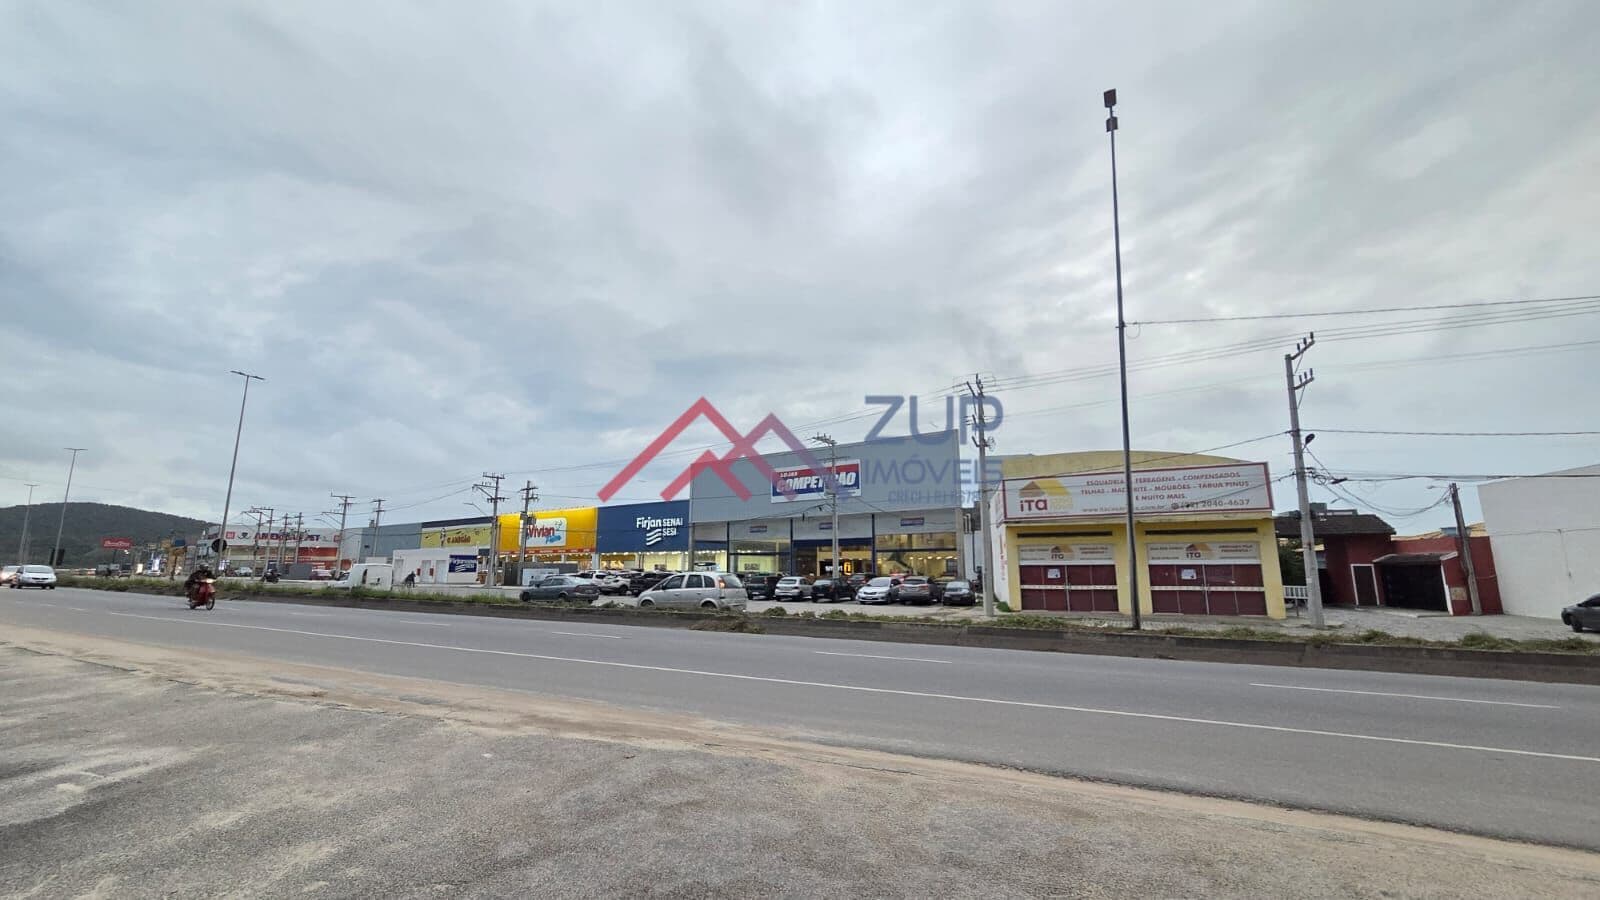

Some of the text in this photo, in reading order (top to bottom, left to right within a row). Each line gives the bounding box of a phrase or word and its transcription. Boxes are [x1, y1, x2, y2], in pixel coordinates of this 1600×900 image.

[1183, 472, 1241, 481] COMPENSADOS
[636, 516, 683, 530] Firjan SENAI
[528, 524, 555, 538] Vivian
[662, 528, 677, 536] SESI
